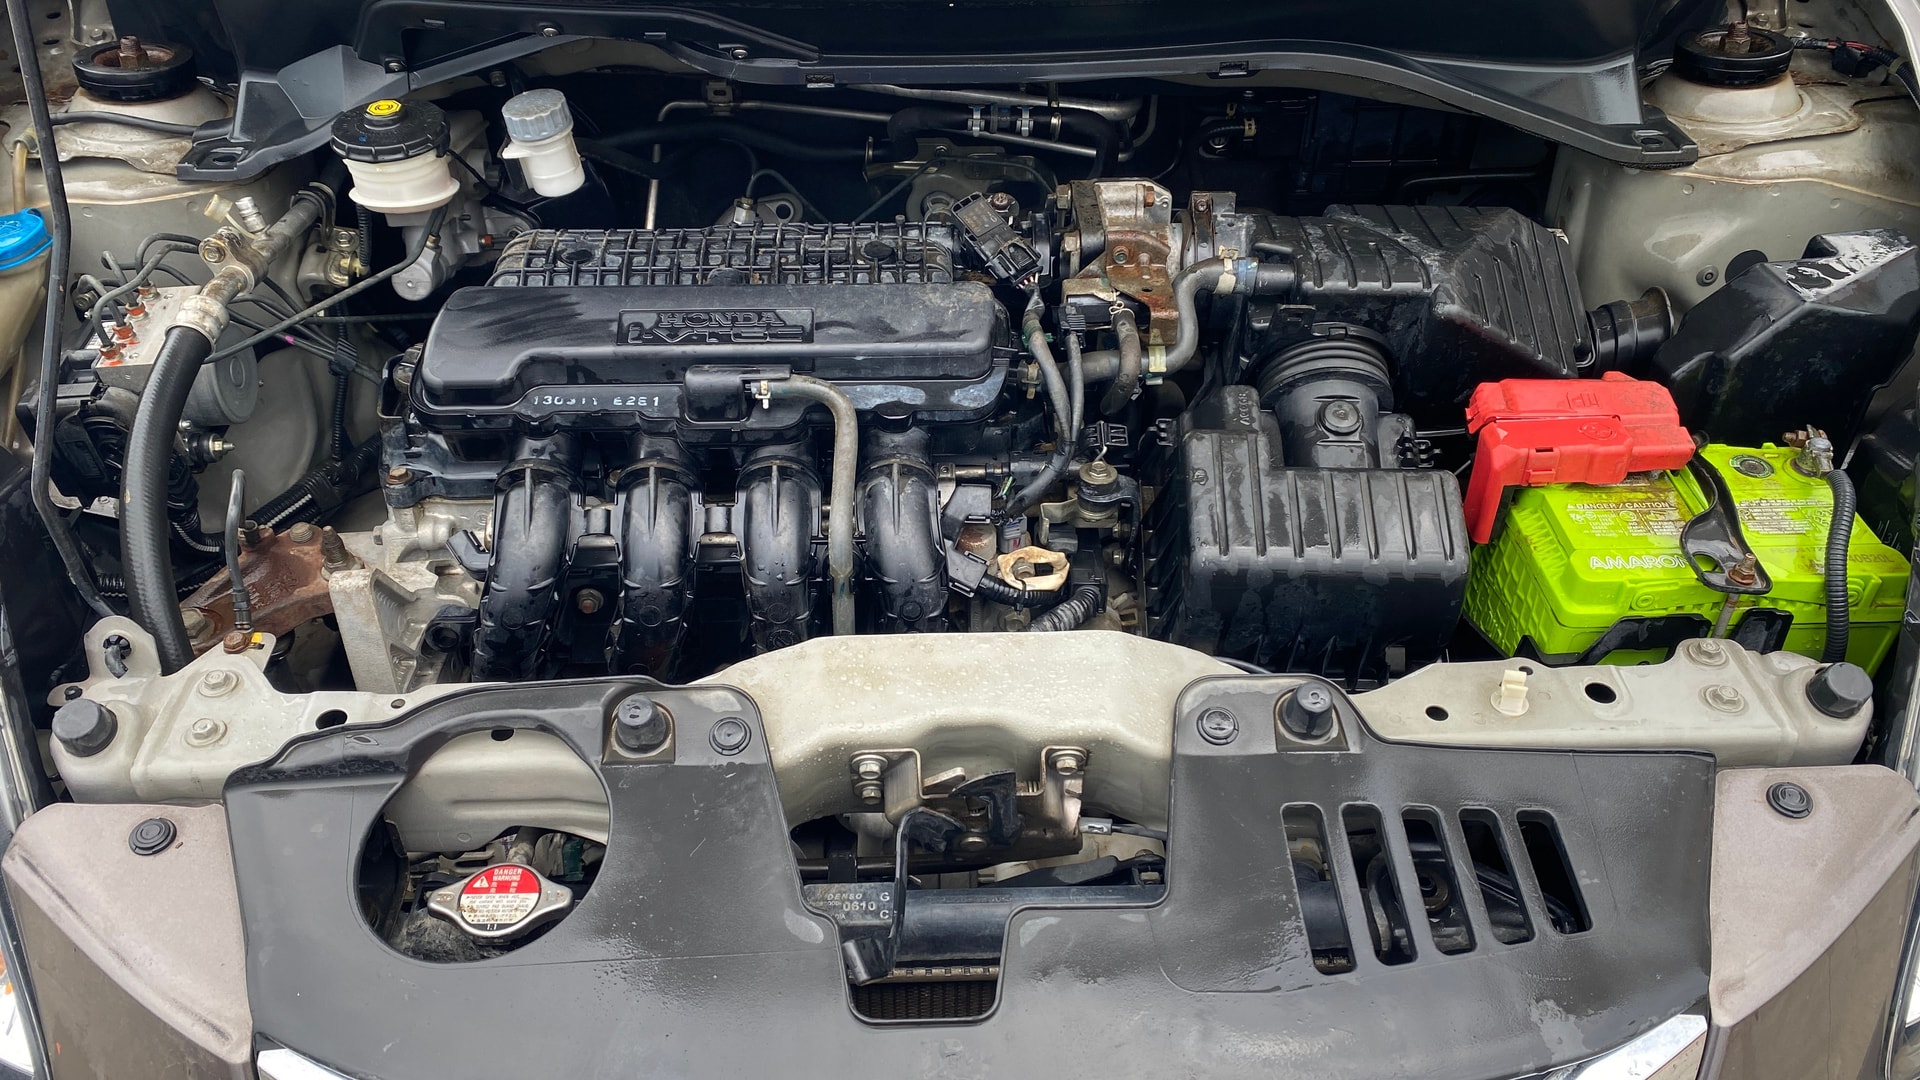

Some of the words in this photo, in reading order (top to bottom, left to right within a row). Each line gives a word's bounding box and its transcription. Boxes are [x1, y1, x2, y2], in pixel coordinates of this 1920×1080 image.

[659, 312, 785, 327] HONDA
[1576, 502, 1617, 510] DANGER
[1624, 502, 1670, 510] CAUTION
[880, 892, 890, 902] G
[842, 901, 876, 911] 0610
[880, 910, 889, 919] C
